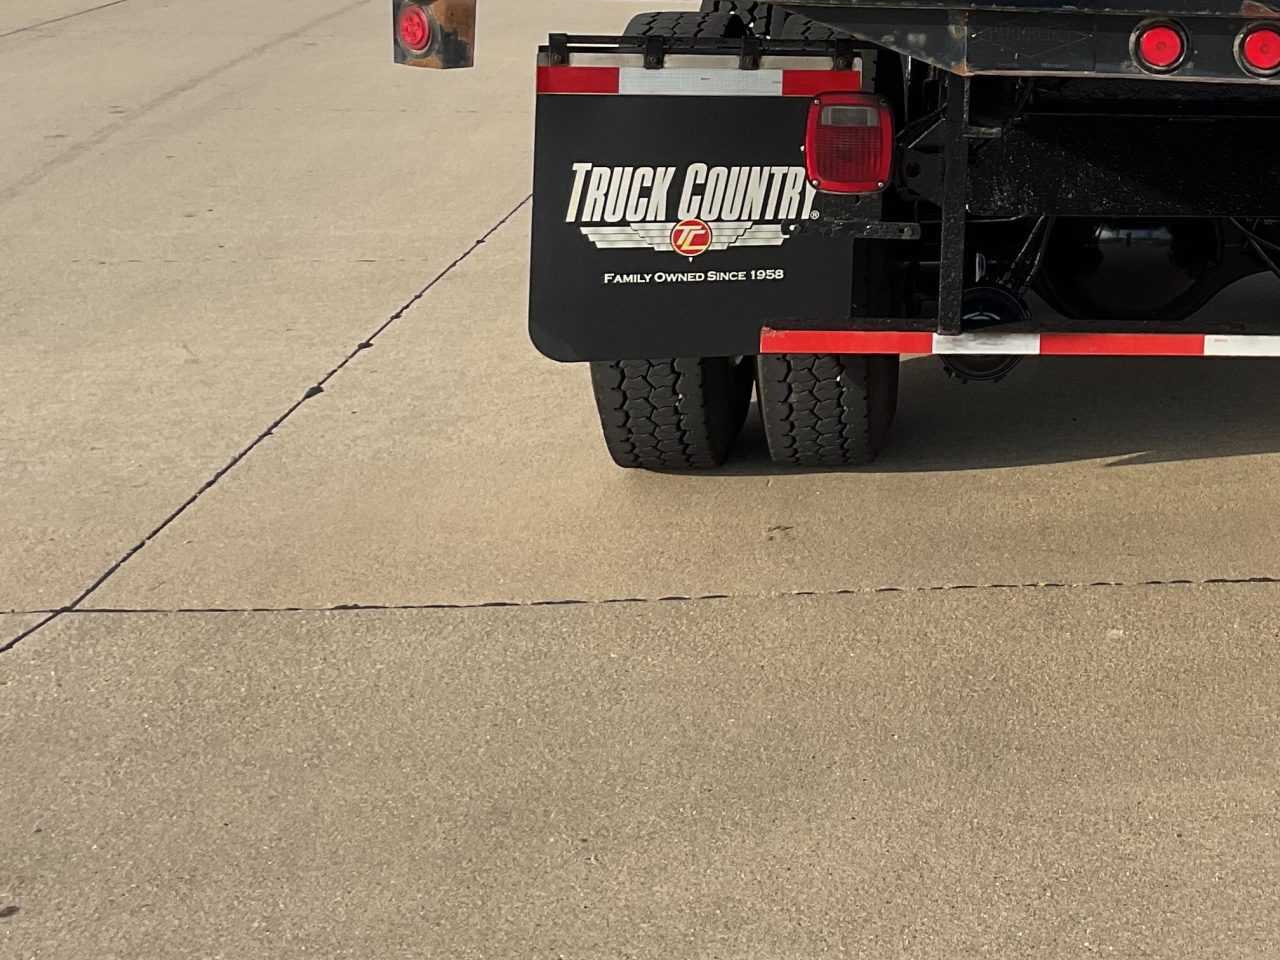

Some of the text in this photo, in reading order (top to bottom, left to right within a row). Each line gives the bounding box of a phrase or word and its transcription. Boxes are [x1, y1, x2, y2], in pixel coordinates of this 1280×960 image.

[566, 162, 817, 222] TRUCK COUNTRY
[604, 269, 785, 283] FAMILY OWNED SINCE 1958
